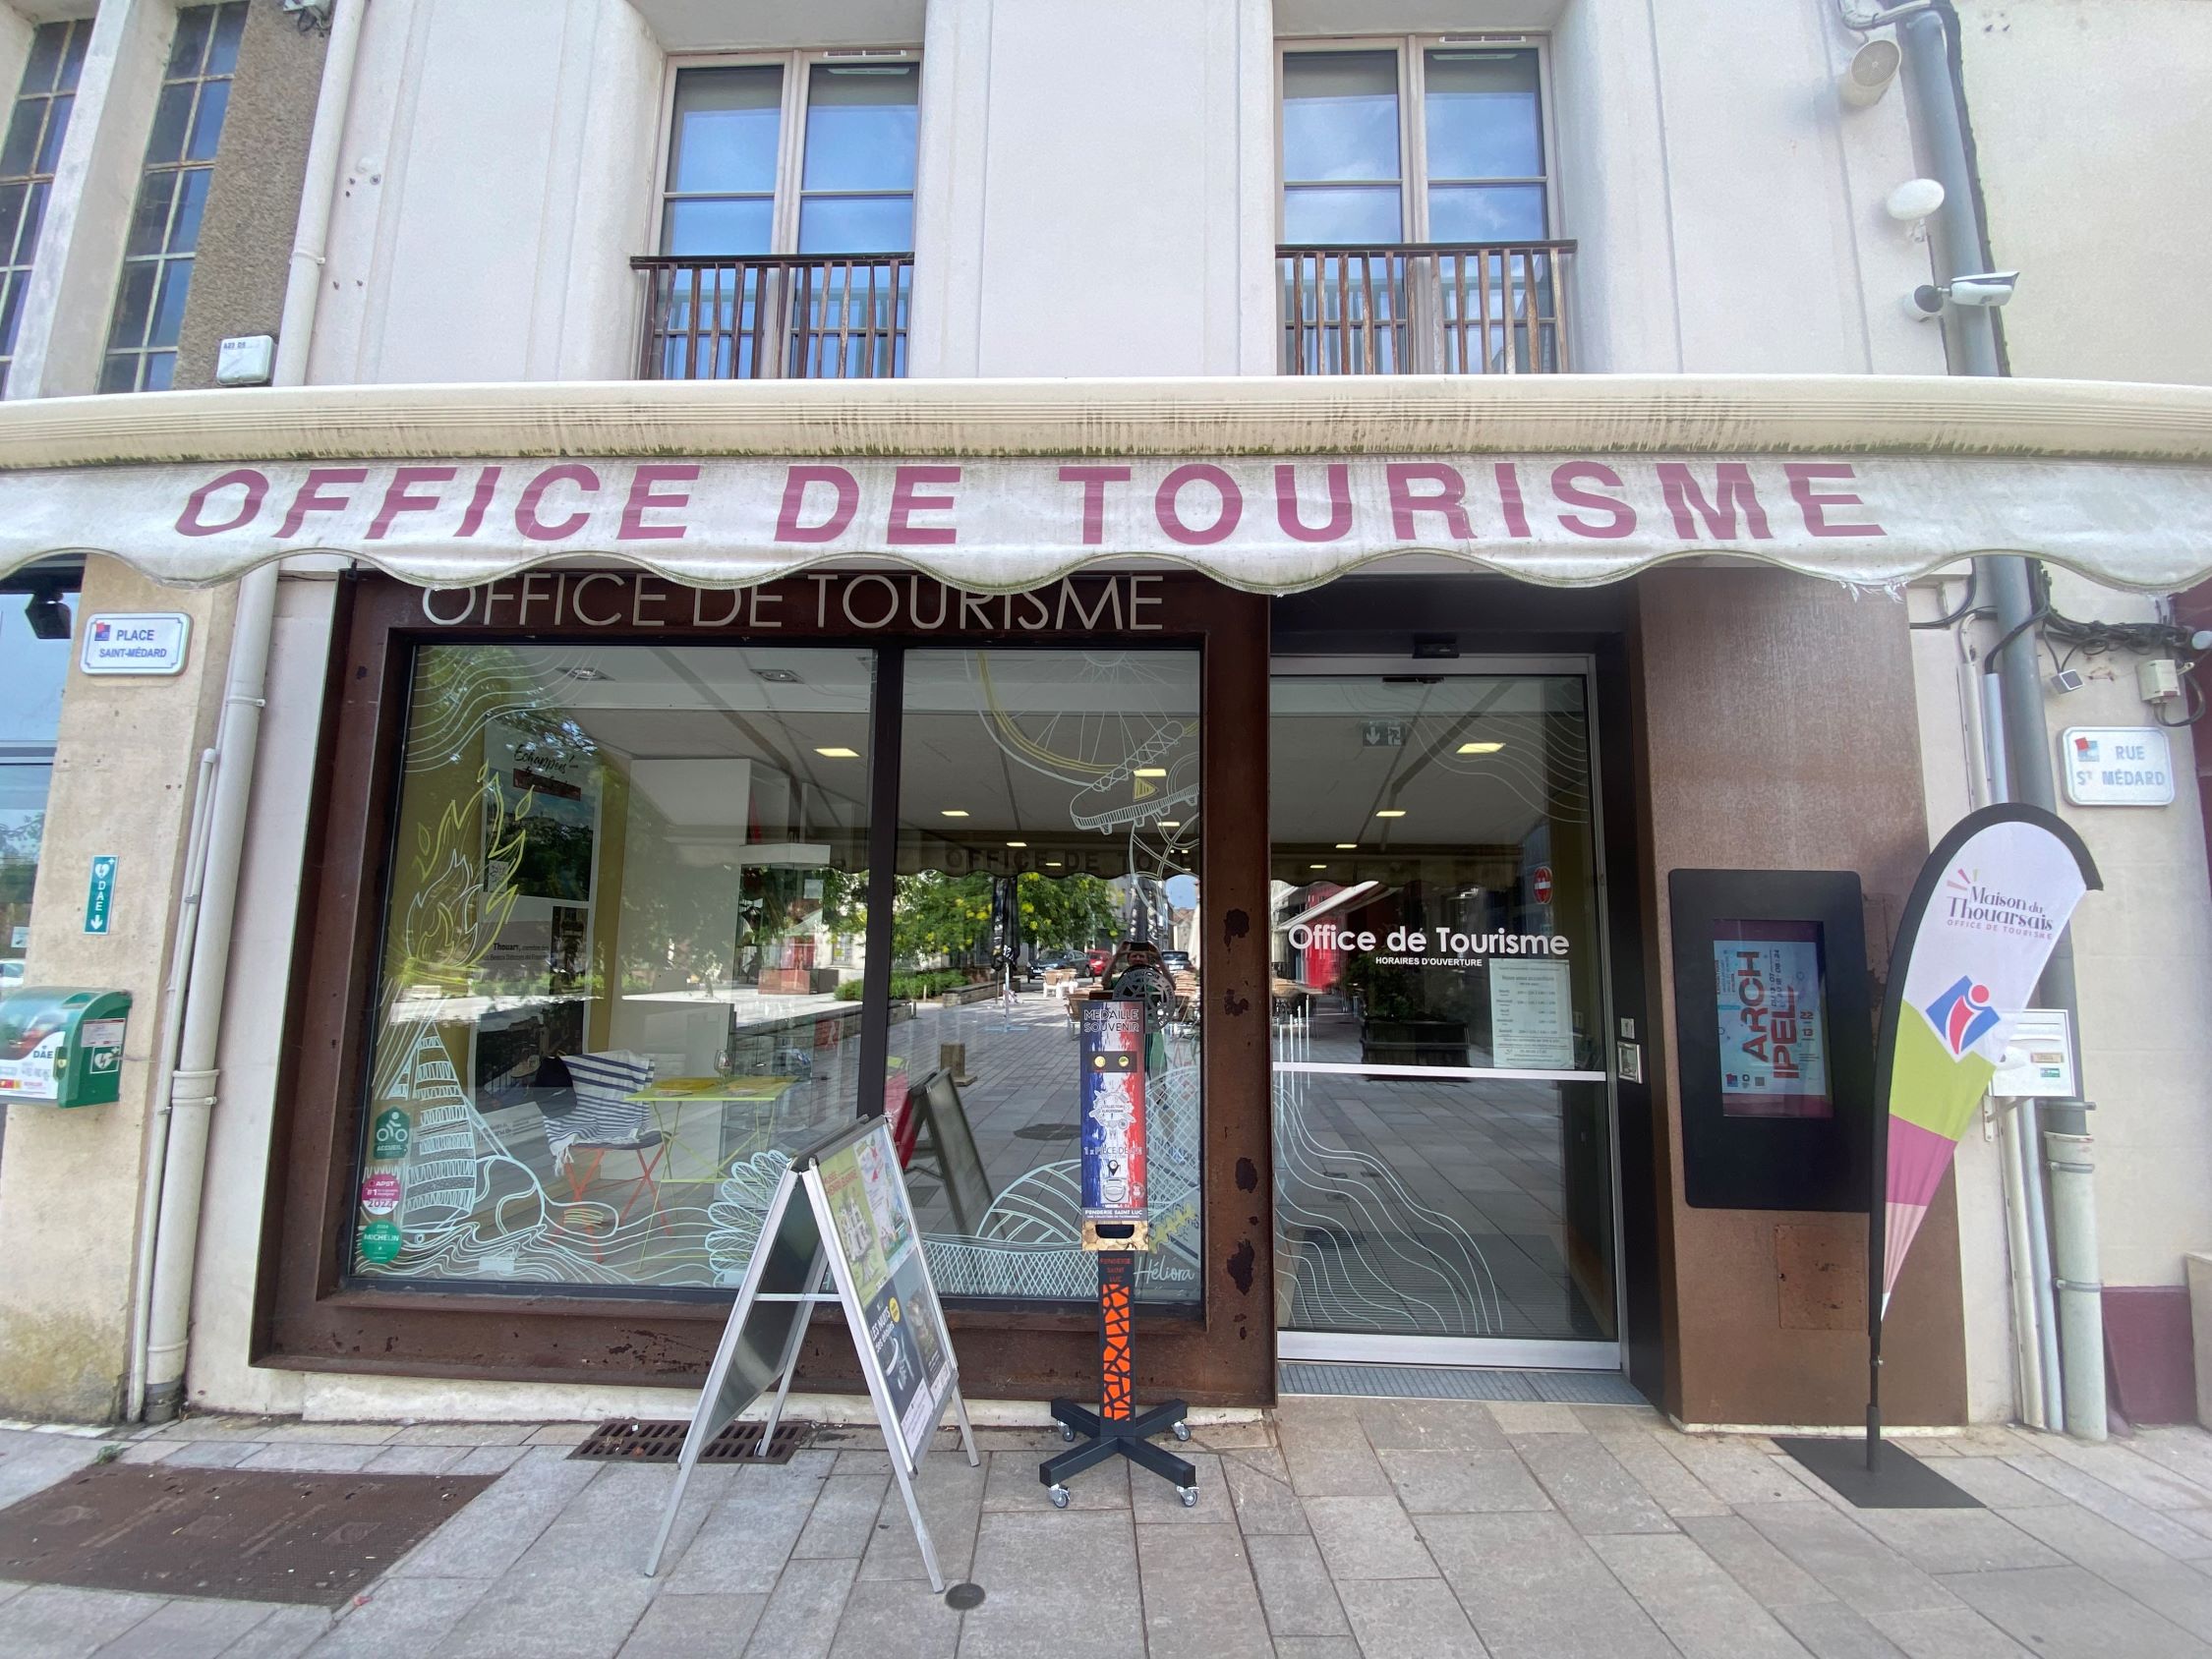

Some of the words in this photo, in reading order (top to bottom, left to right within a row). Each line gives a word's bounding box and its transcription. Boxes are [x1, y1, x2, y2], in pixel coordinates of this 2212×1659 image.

[174, 464, 701, 541] OFFICE
[773, 465, 962, 545] DE
[1058, 460, 1889, 545] TOURISME
[422, 572, 667, 627] OFFICE
[692, 580, 783, 628] DE
[807, 574, 1164, 630] TOURISME
[116, 629, 155, 642] PLACE
[98, 646, 167, 658] SAINT-MÉDARD
[2115, 745, 2145, 761] RUE
[2101, 769, 2166, 786] MÉDARD
[94, 880, 106, 912] DAE
[1969, 886, 2026, 911] Maison
[2028, 901, 2043, 914] du
[1947, 895, 2054, 931] Thouarsais
[1288, 923, 1376, 951] Office
[1386, 926, 1426, 952] de
[1435, 927, 1570, 955] Tourisme
[1947, 919, 1982, 930] OFFICE
[1986, 923, 1999, 932] DE
[2004, 926, 2054, 941] TOURISME
[1736, 950, 1769, 1063] ARCH
[1083, 1021, 1140, 1033] SOUVENIR
[1771, 985, 1800, 1079] IPEL
[32, 1051, 54, 1059] DAE
[367, 1197, 394, 1209] 2024
[363, 1233, 400, 1242] MICHELIN
